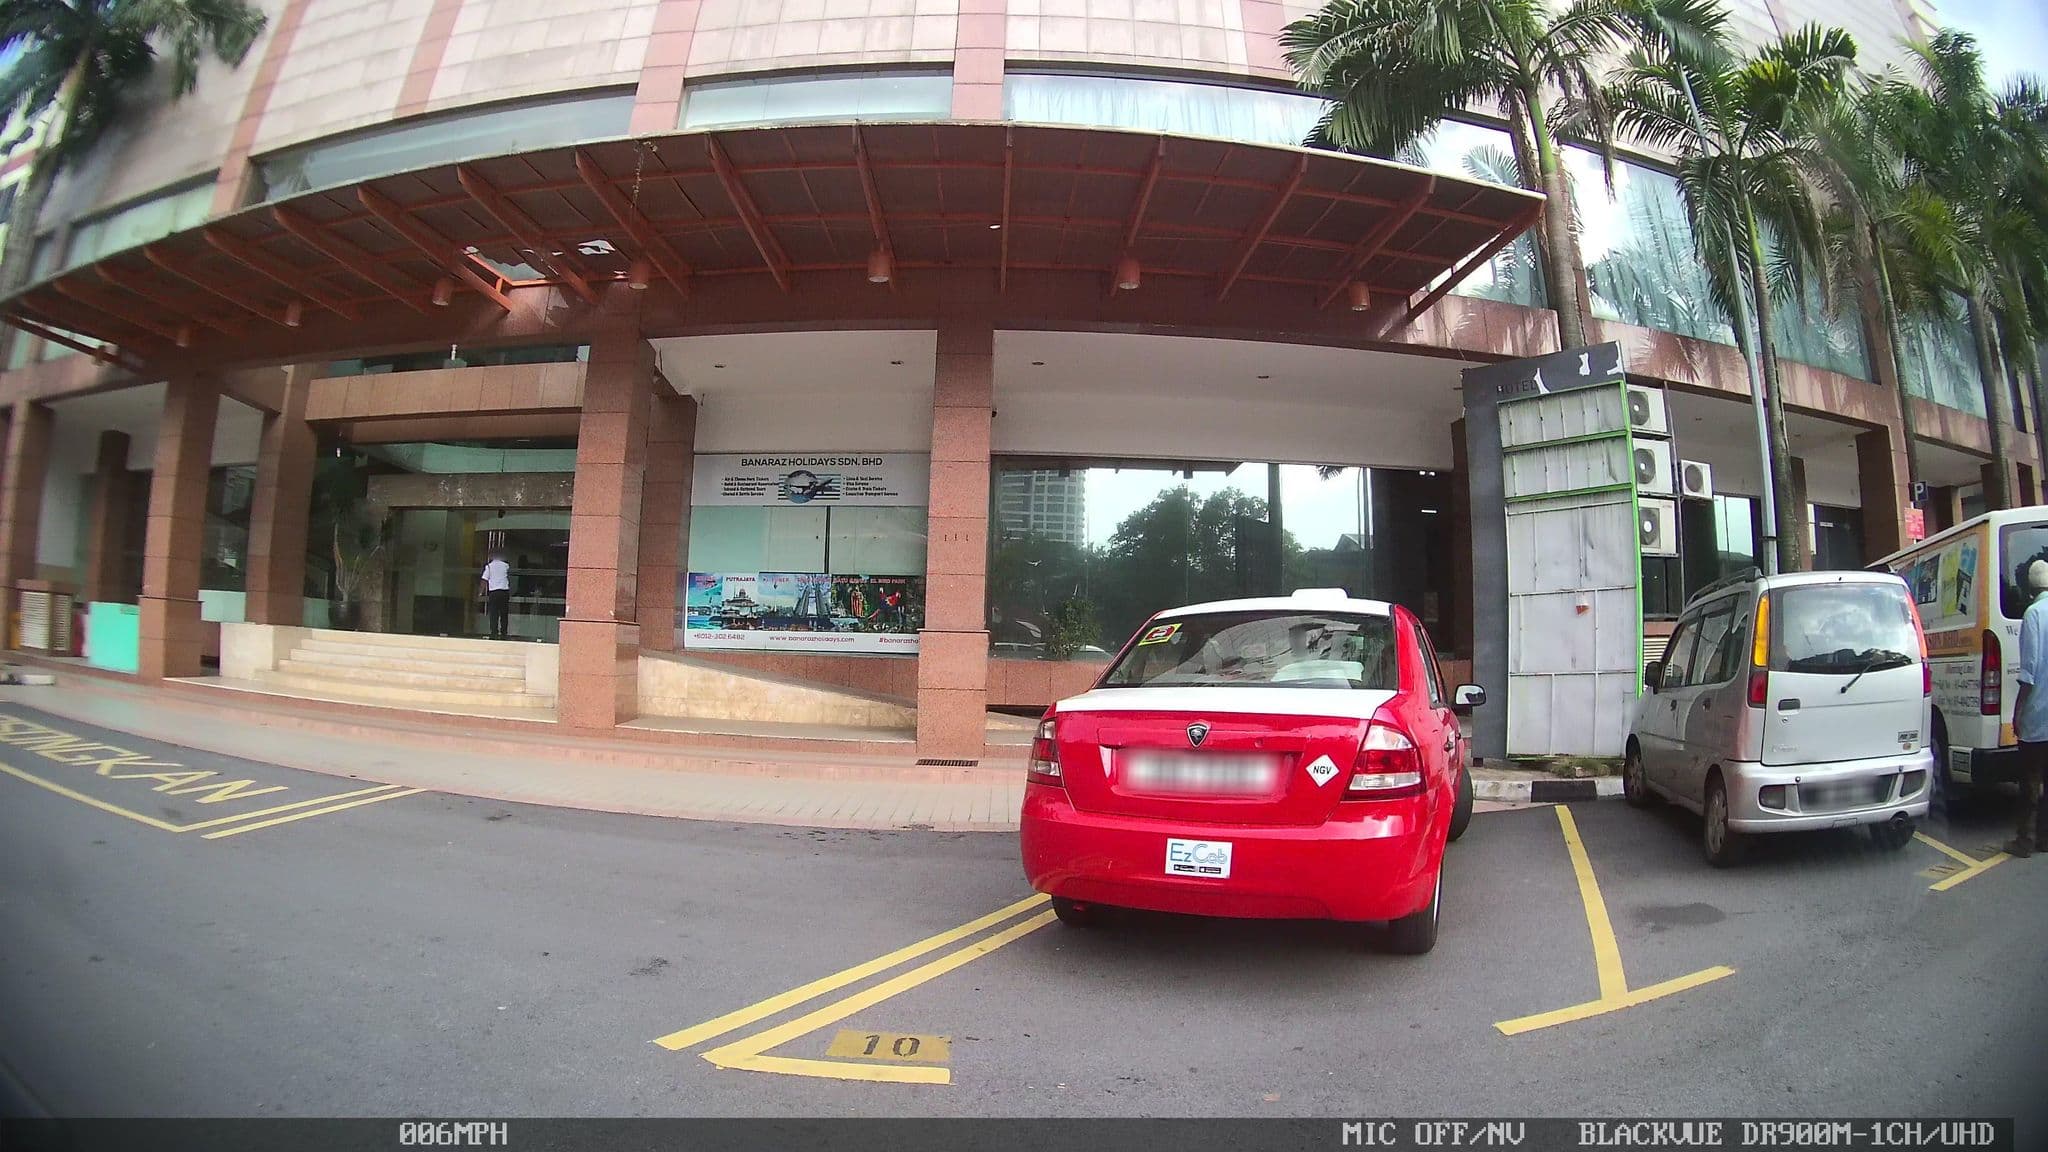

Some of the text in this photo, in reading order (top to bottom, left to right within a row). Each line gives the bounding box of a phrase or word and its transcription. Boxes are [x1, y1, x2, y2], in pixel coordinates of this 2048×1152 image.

[741, 457, 883, 467] BANARAZ HOLIDAYS SDN. BHD
[1313, 765, 1332, 775] NGV
[1170, 843, 1228, 864] EzCab
[863, 1034, 920, 1057] 10
